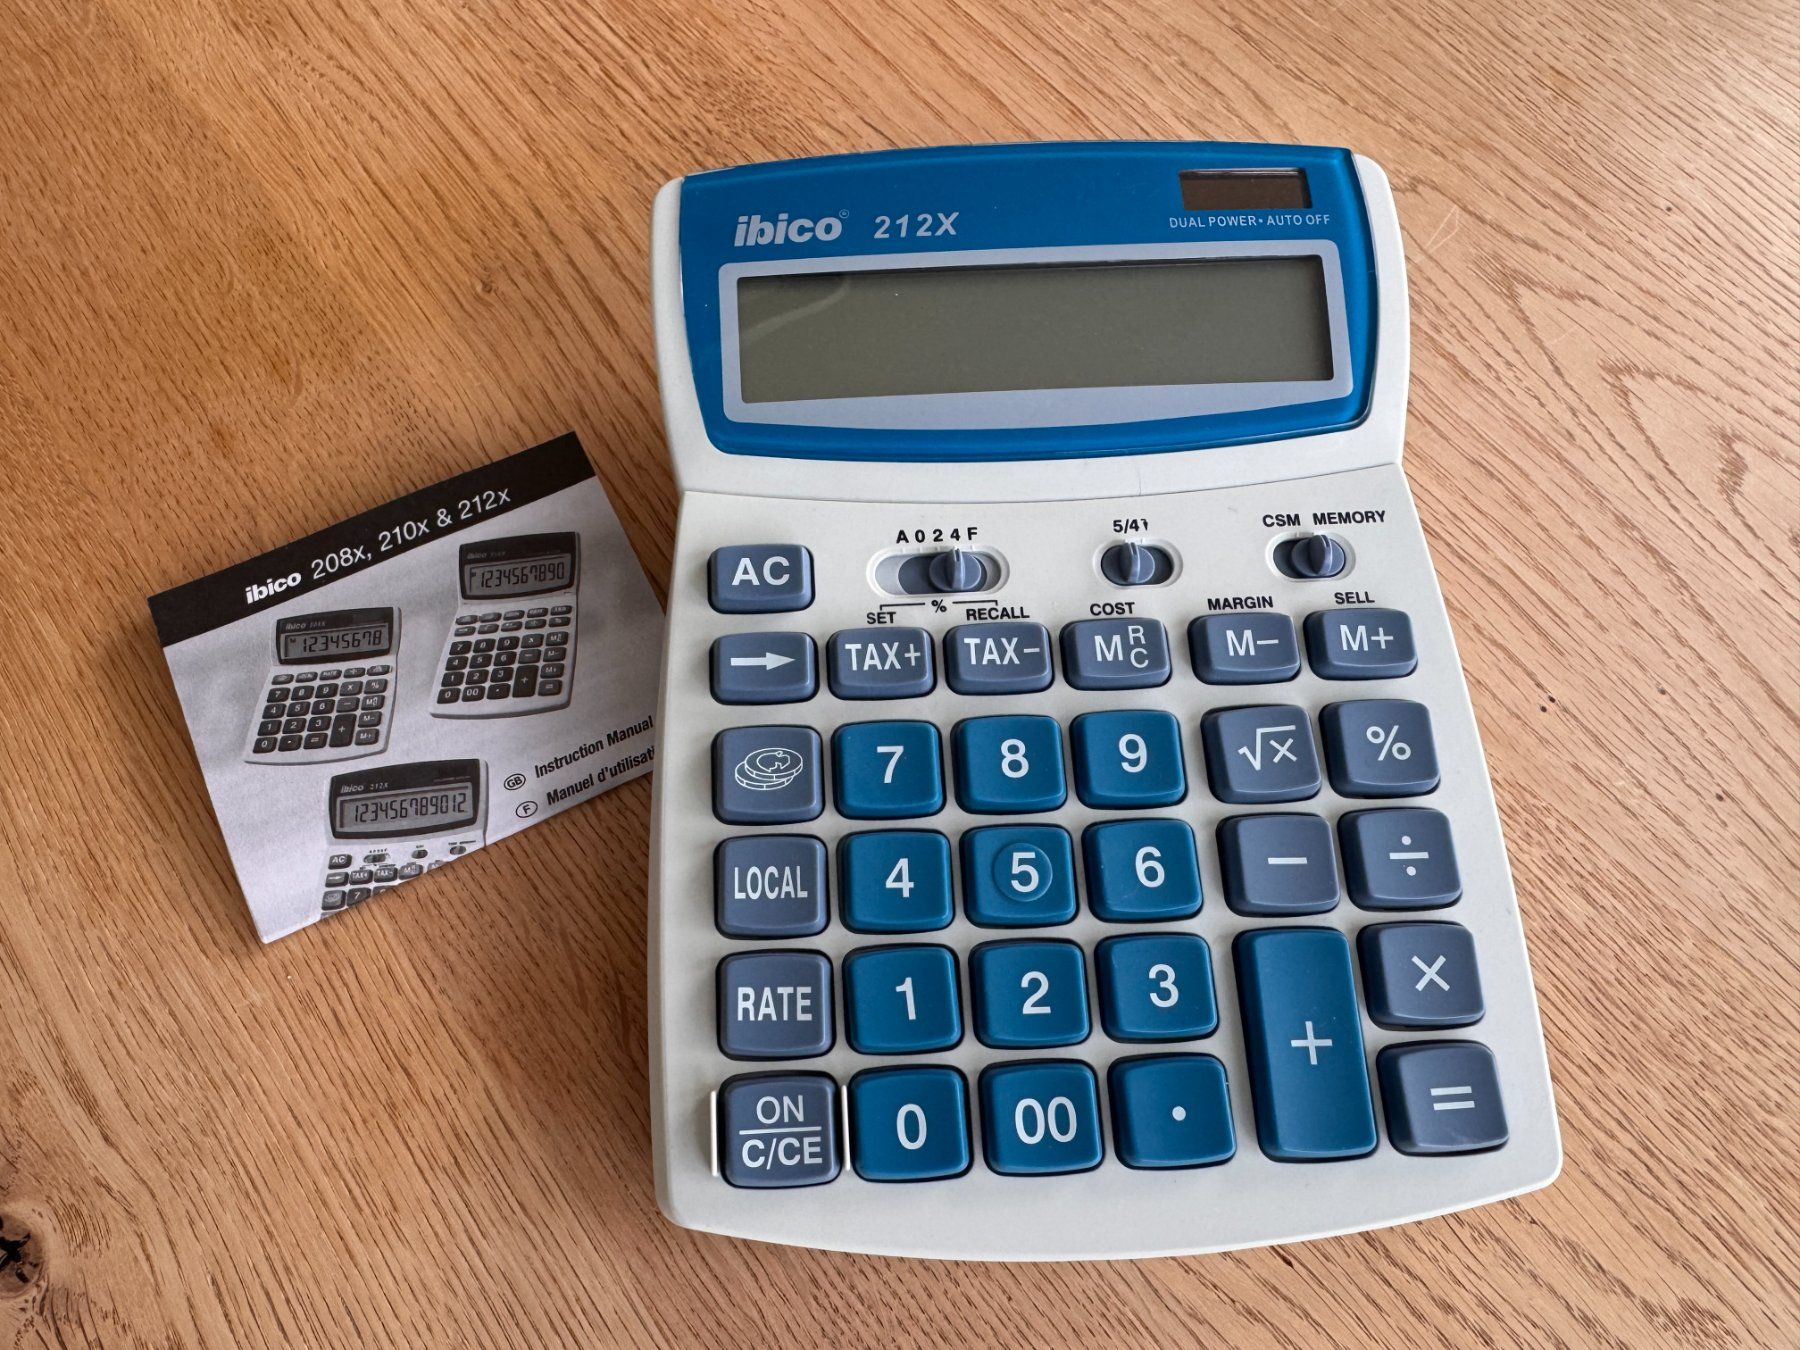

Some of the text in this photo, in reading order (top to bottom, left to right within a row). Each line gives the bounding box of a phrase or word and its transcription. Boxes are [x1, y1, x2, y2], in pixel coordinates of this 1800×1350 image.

[734, 212, 959, 247] ibico 212X
[1169, 214, 1330, 228] DUAL POWER AUTO OFF
[1262, 510, 1386, 527] CSM MEMORY
[245, 488, 511, 604] ibico 208x, 210x & 212x
[896, 530, 910, 544] A
[932, 529, 944, 542] 2
[950, 528, 961, 541] 4
[967, 527, 978, 540] F
[480, 562, 564, 588] 1234567890
[732, 556, 789, 585] AC
[1089, 602, 1135, 616] COST
[1207, 596, 1273, 611] MARGIN
[1334, 592, 1375, 605] SELL
[866, 611, 897, 624] SET
[966, 607, 1030, 621] RECALL
[303, 629, 382, 652] 12345678
[1340, 625, 1393, 650] M+
[845, 642, 920, 670] TAX+
[534, 716, 654, 778] Instruction Manual
[1001, 739, 1028, 778] 8
[1119, 734, 1146, 772] 9
[1366, 726, 1410, 760] %
[877, 746, 903, 783] 7
[507, 776, 522, 789] GB
[546, 774, 594, 805] Manuel
[355, 792, 466, 823] 123456789012
[522, 804, 531, 814] F
[735, 866, 807, 899] LOCAL
[886, 858, 914, 897] 4
[1012, 852, 1038, 892] 5
[1136, 847, 1164, 887] 6
[896, 978, 915, 1019] 1
[1021, 971, 1051, 1014] 2
[1149, 964, 1178, 1007] 3
[738, 987, 811, 1020] RATE
[757, 1096, 803, 1124] ON
[1015, 1097, 1076, 1144] 00
[897, 1104, 926, 1149] 0
[742, 1137, 822, 1169] C/CE
